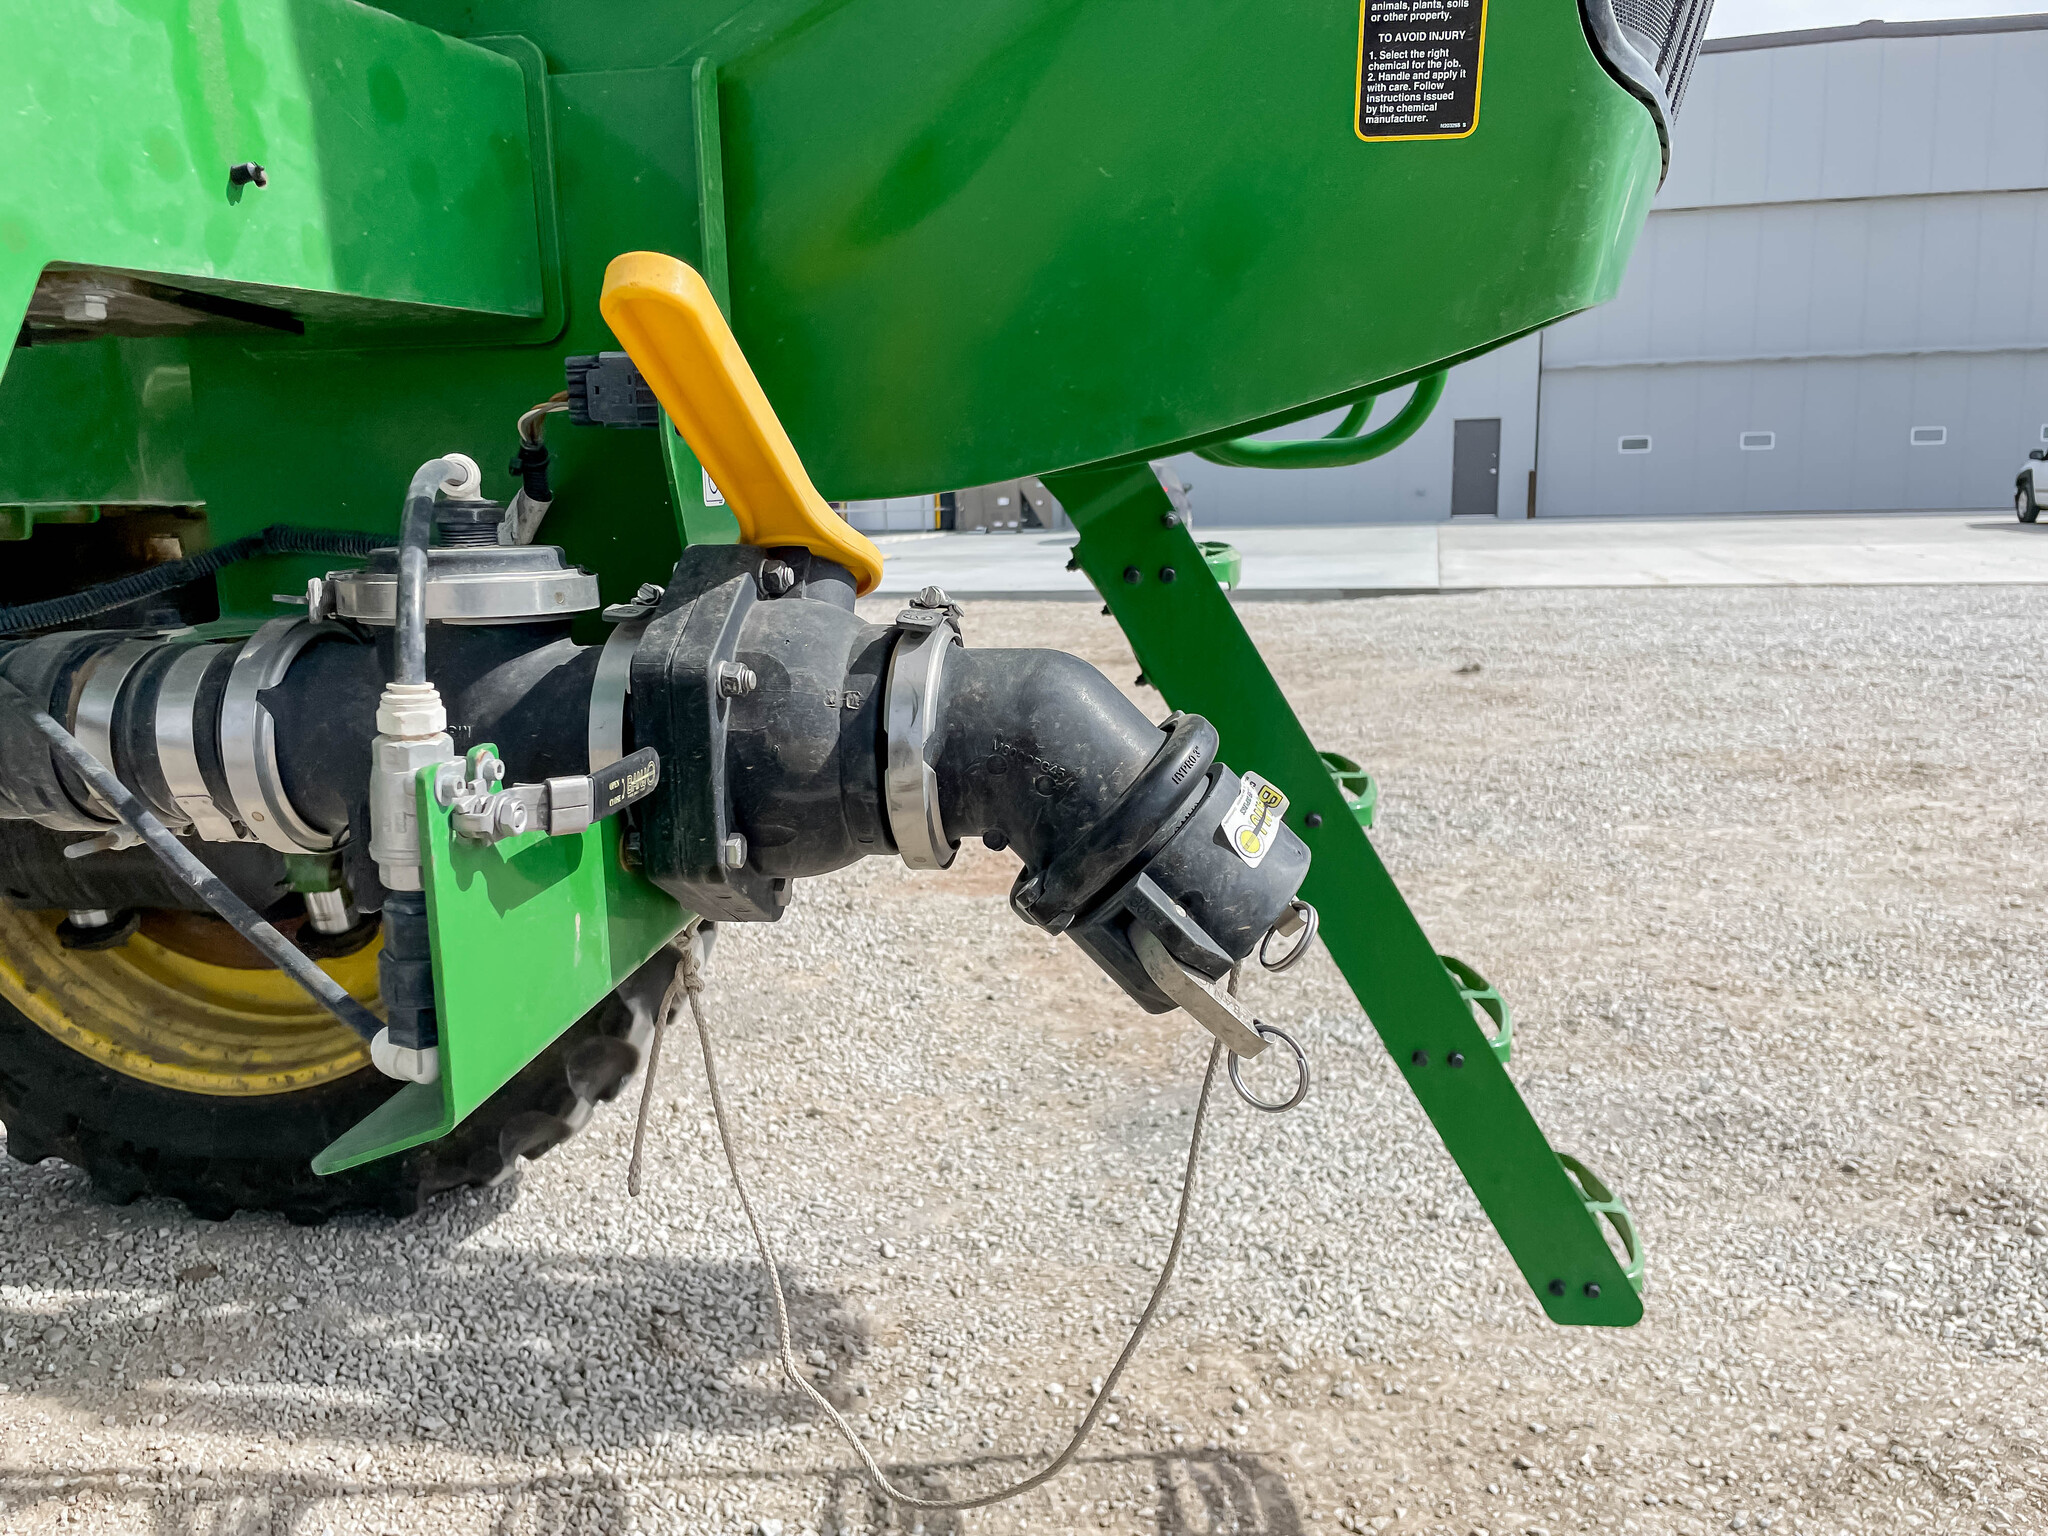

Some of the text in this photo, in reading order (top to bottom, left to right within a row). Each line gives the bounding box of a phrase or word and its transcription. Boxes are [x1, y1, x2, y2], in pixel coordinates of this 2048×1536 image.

[1371, 0, 1469, 11] animals, plants, soils
[1370, 11, 1452, 23] or other property.
[1378, 30, 1466, 43] TO AVOID INJURY
[1369, 48, 1449, 60] 1. Select the right
[1368, 59, 1461, 71] chemical for the job.
[1367, 69, 1467, 82] 2. Handle and apply it
[1367, 81, 1444, 92] with care. Follow
[1366, 91, 1454, 103] instructions issued
[1365, 102, 1438, 115] by the chemical
[1365, 114, 1429, 124] manufacturer.
[1171, 754, 1197, 785] HYPRO
